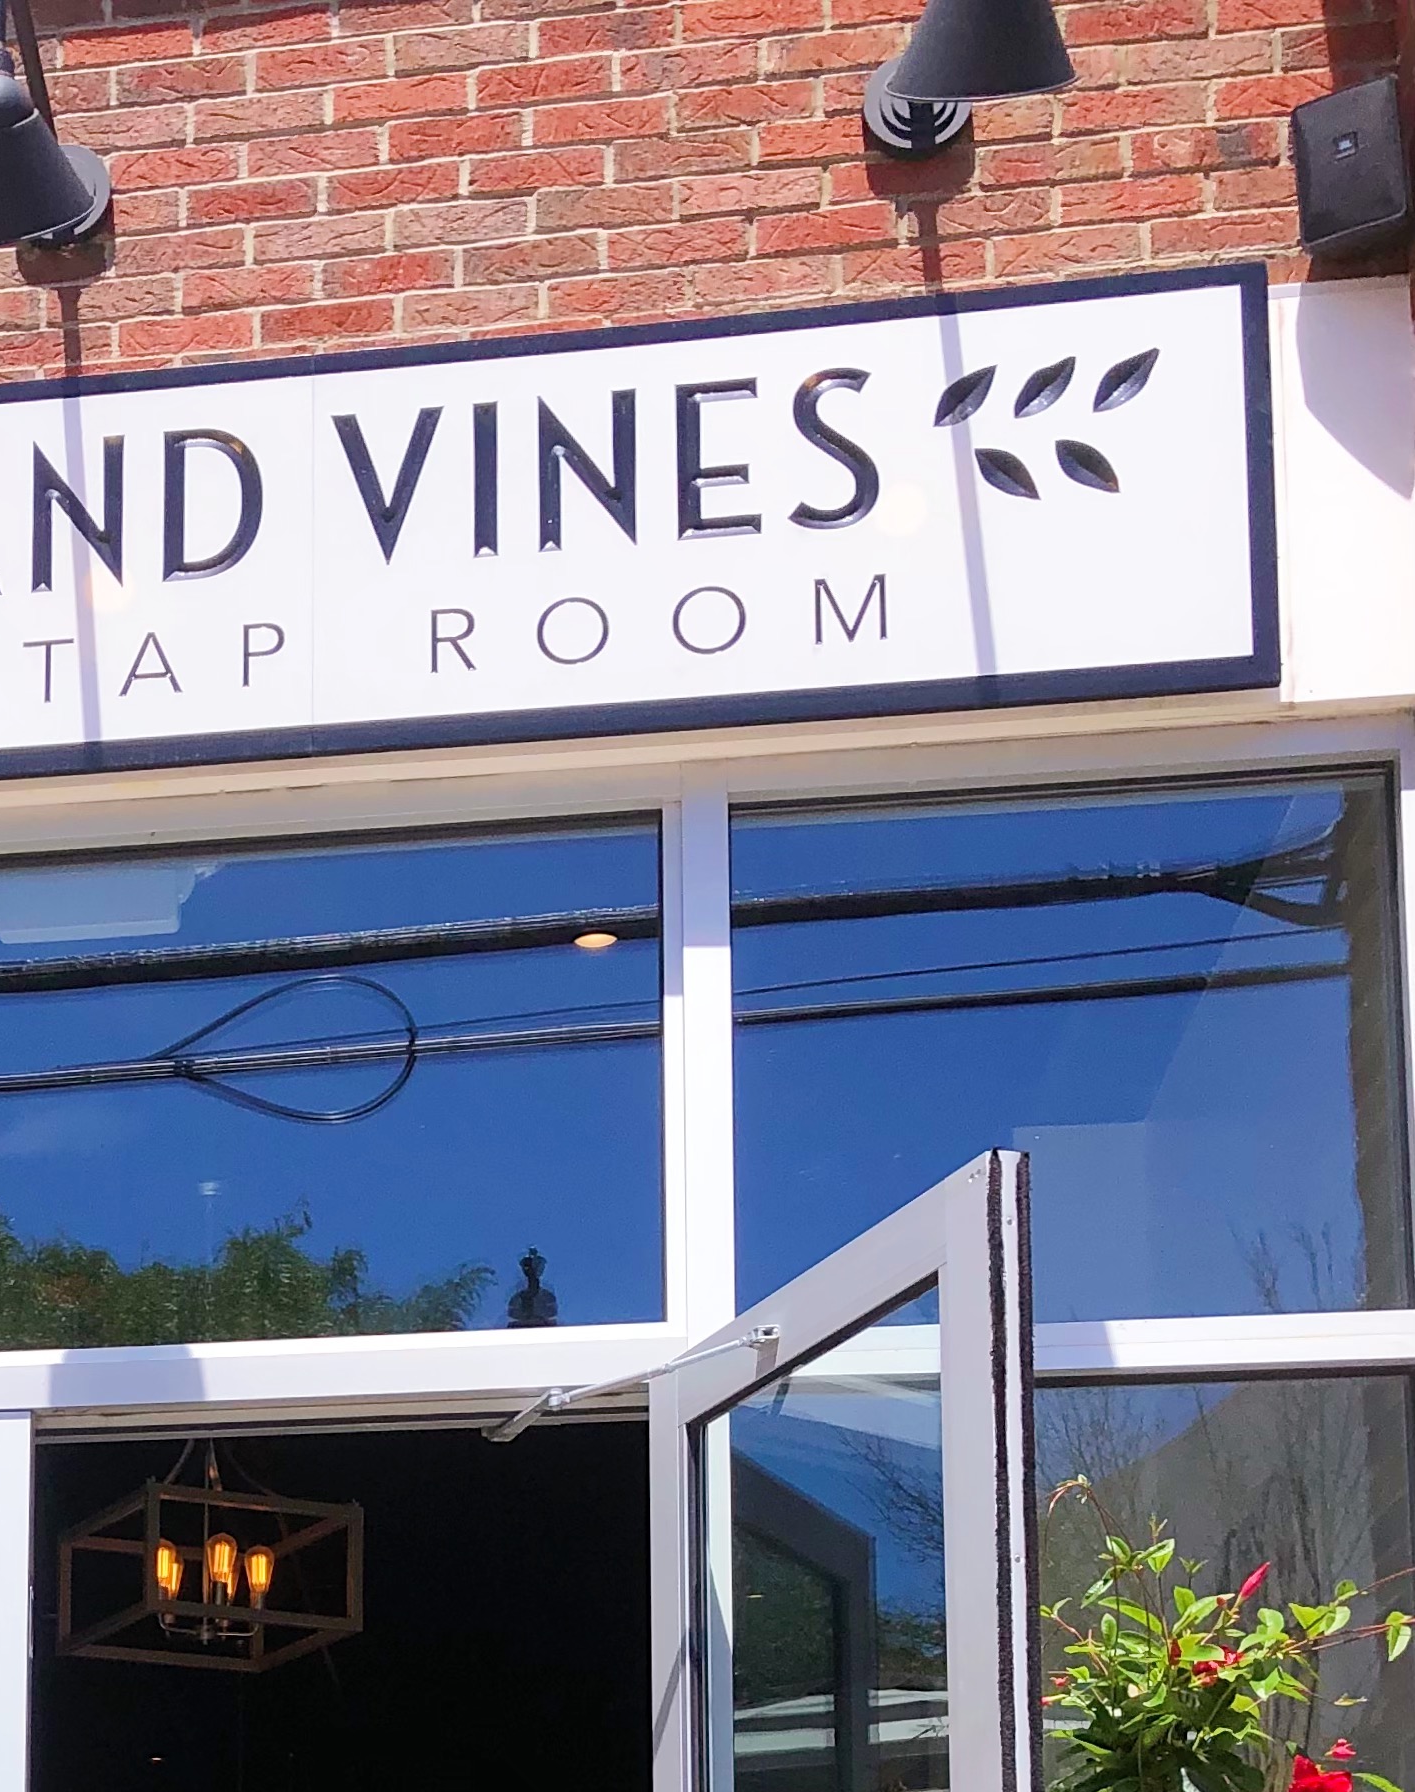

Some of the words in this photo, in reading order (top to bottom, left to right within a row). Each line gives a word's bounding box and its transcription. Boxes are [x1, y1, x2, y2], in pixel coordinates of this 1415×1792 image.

[331, 367, 880, 565] VINES
[23, 623, 285, 703] TAP
[431, 573, 888, 673] ROOM
